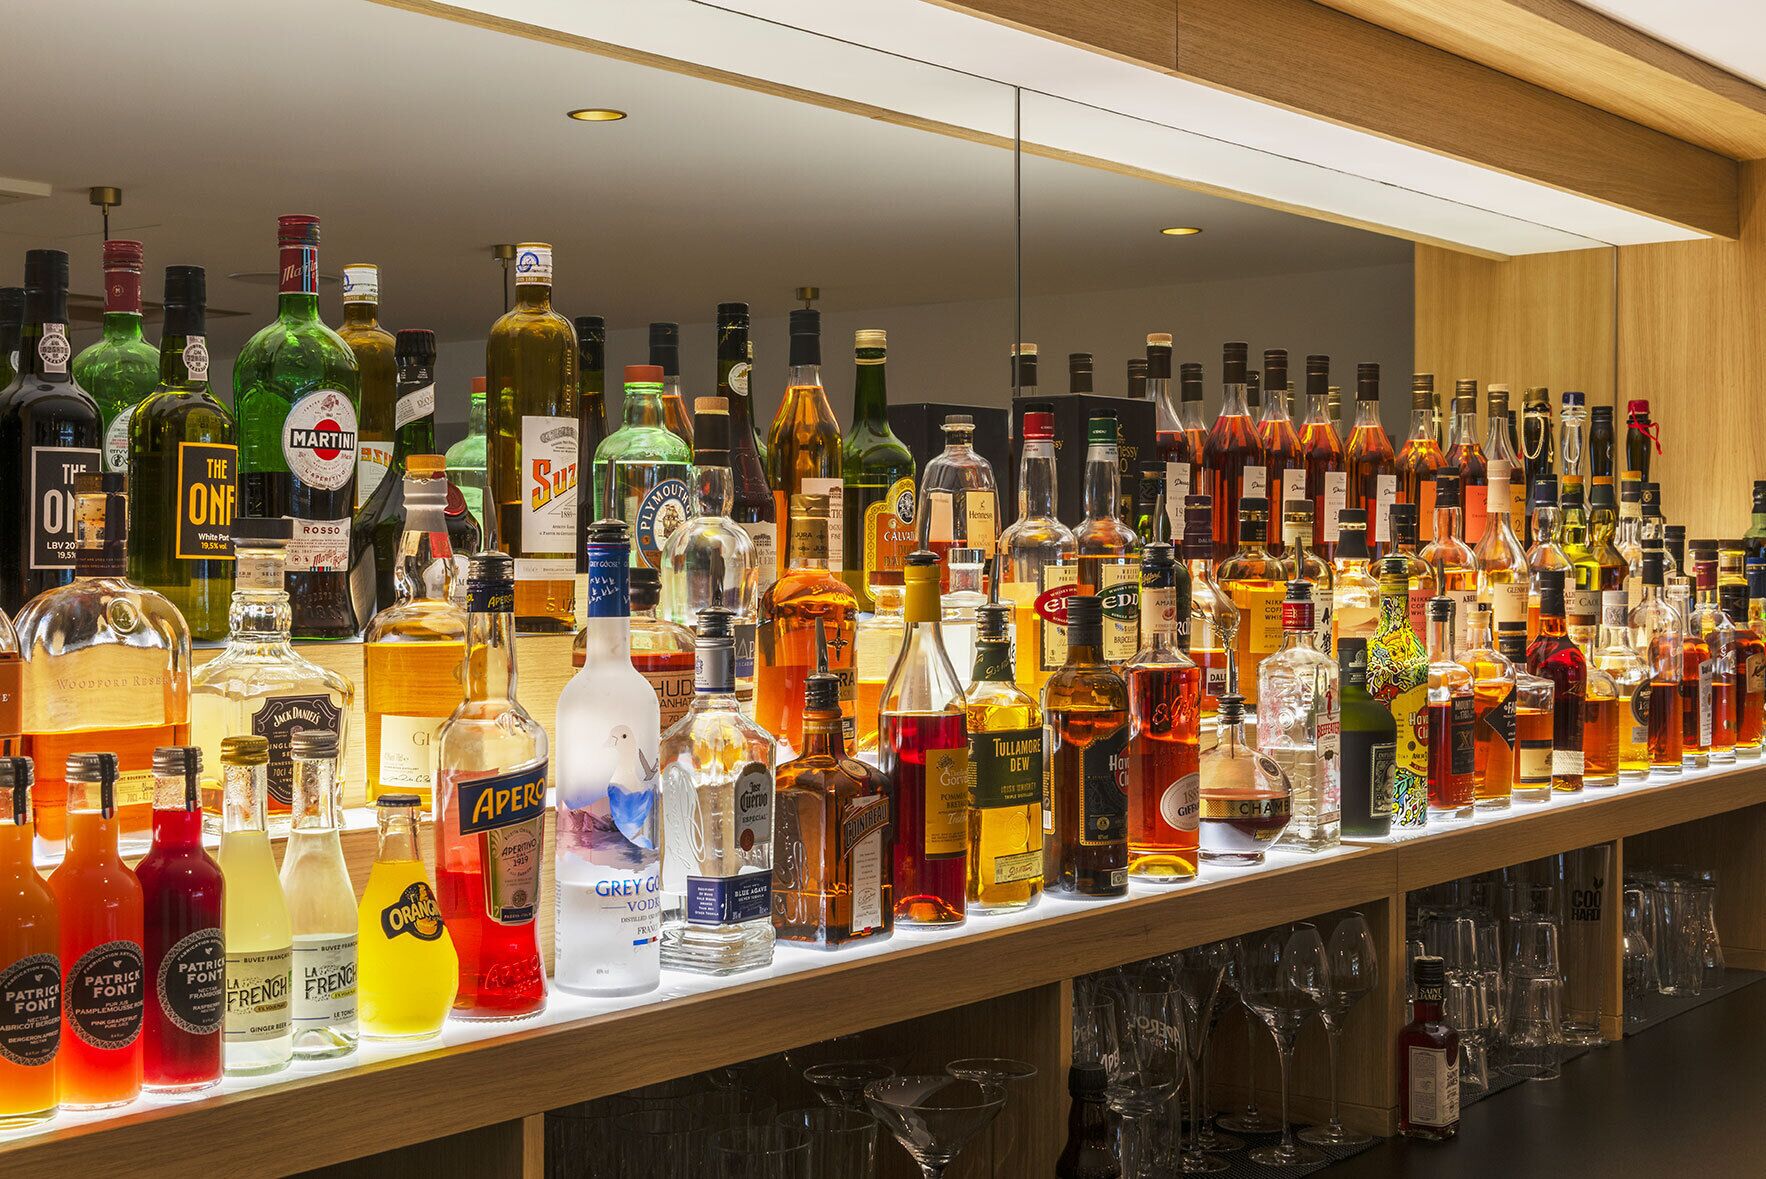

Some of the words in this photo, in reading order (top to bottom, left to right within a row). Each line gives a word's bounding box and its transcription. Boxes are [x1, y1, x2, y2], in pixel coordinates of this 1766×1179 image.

[292, 430, 354, 450] MARTINI
[207, 458, 228, 480] THE
[532, 459, 577, 512] Suz
[43, 489, 74, 535] ON
[640, 483, 689, 530] PLYMOUTH
[198, 533, 219, 541] White
[303, 526, 340, 535] ROSSO
[46, 541, 64, 550] LBV
[487, 593, 513, 609] APERO
[1102, 592, 1139, 609] EDD
[56, 678, 128, 691] WOODFORD
[1210, 673, 1227, 682] DAL
[273, 711, 292, 727] JACK
[292, 706, 321, 725] DANIEL'S
[993, 737, 1041, 758] TULLAMORE
[1009, 757, 1030, 773] DEW
[940, 769, 968, 786] Gorv
[471, 777, 545, 825] APERO
[740, 790, 768, 813] Cuervo
[1177, 802, 1200, 817] GIFF
[742, 814, 767, 824] ESPECIAL
[846, 801, 887, 849] COINTREAU
[502, 838, 537, 857] APERITIVO
[513, 856, 529, 868] 1919
[595, 878, 642, 897] GREY
[734, 889, 749, 897] BLUE
[750, 885, 768, 894] AGAVE
[178, 957, 226, 974] PATRICK
[243, 955, 266, 964] BUVEZ
[85, 969, 141, 987] PATRICK
[186, 968, 224, 985] FONT
[304, 966, 318, 978] LA
[93, 982, 138, 999] FONT
[226, 978, 240, 989] LA
[1419, 986, 1442, 995] SAINT
[5, 983, 60, 1002] PATRICK
[226, 974, 288, 1011] FRENCH
[1418, 992, 1442, 1000] JAMES
[15, 996, 57, 1014] FONT
[75, 1002, 132, 1015] PAMPLEMOUSSE
[0, 1020, 35, 1032] ABRICOT
[249, 1025, 273, 1034] GINGER
[274, 1021, 288, 1031] BEER
